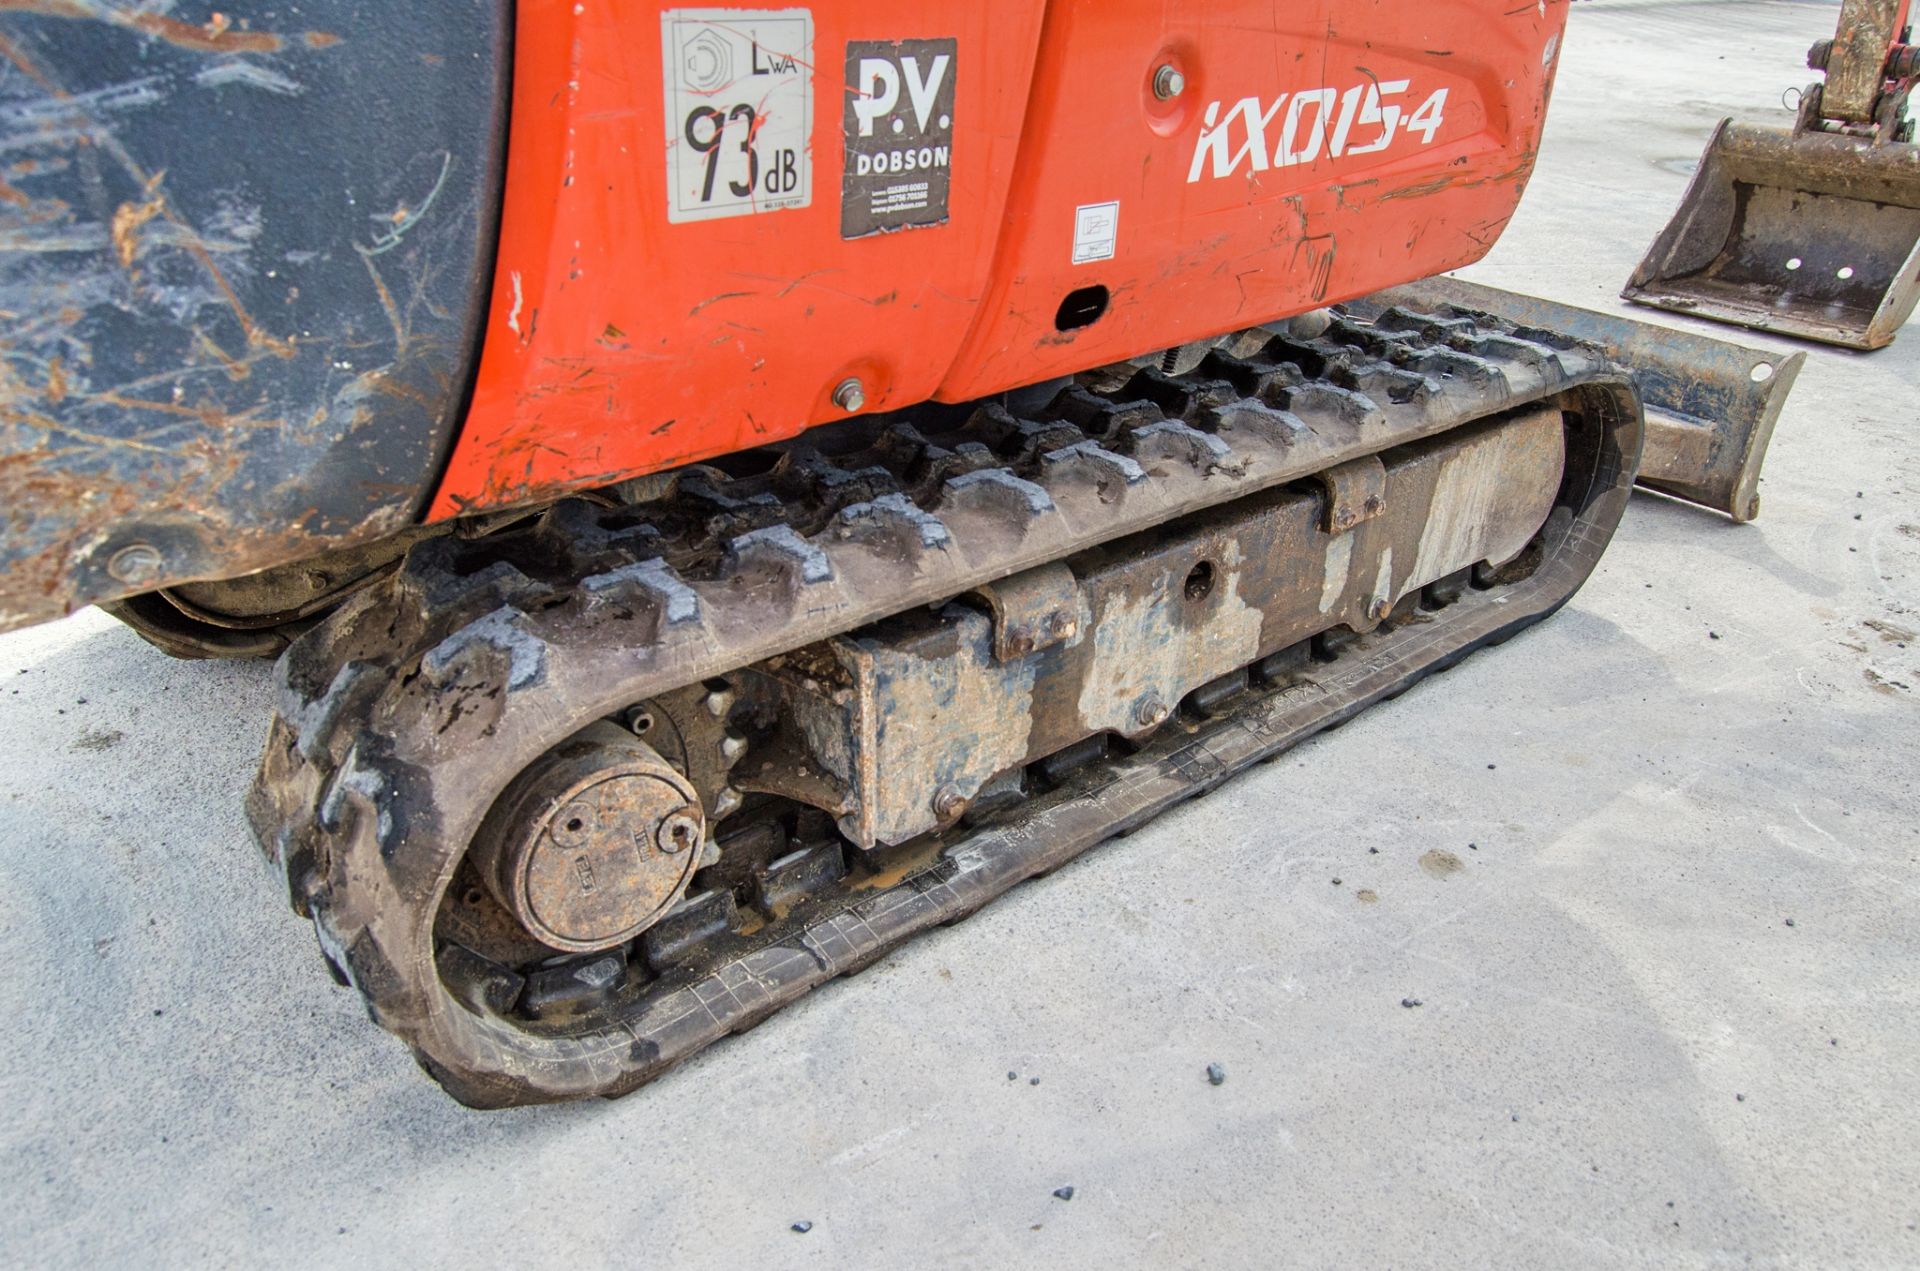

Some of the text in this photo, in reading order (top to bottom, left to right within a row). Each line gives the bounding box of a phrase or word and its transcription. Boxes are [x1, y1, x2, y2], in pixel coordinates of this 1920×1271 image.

[852, 54, 950, 136] P.V.
[1187, 79, 1449, 183] KX015-4
[685, 103, 797, 202] 93 dB
[857, 146, 948, 175] DOBSON
